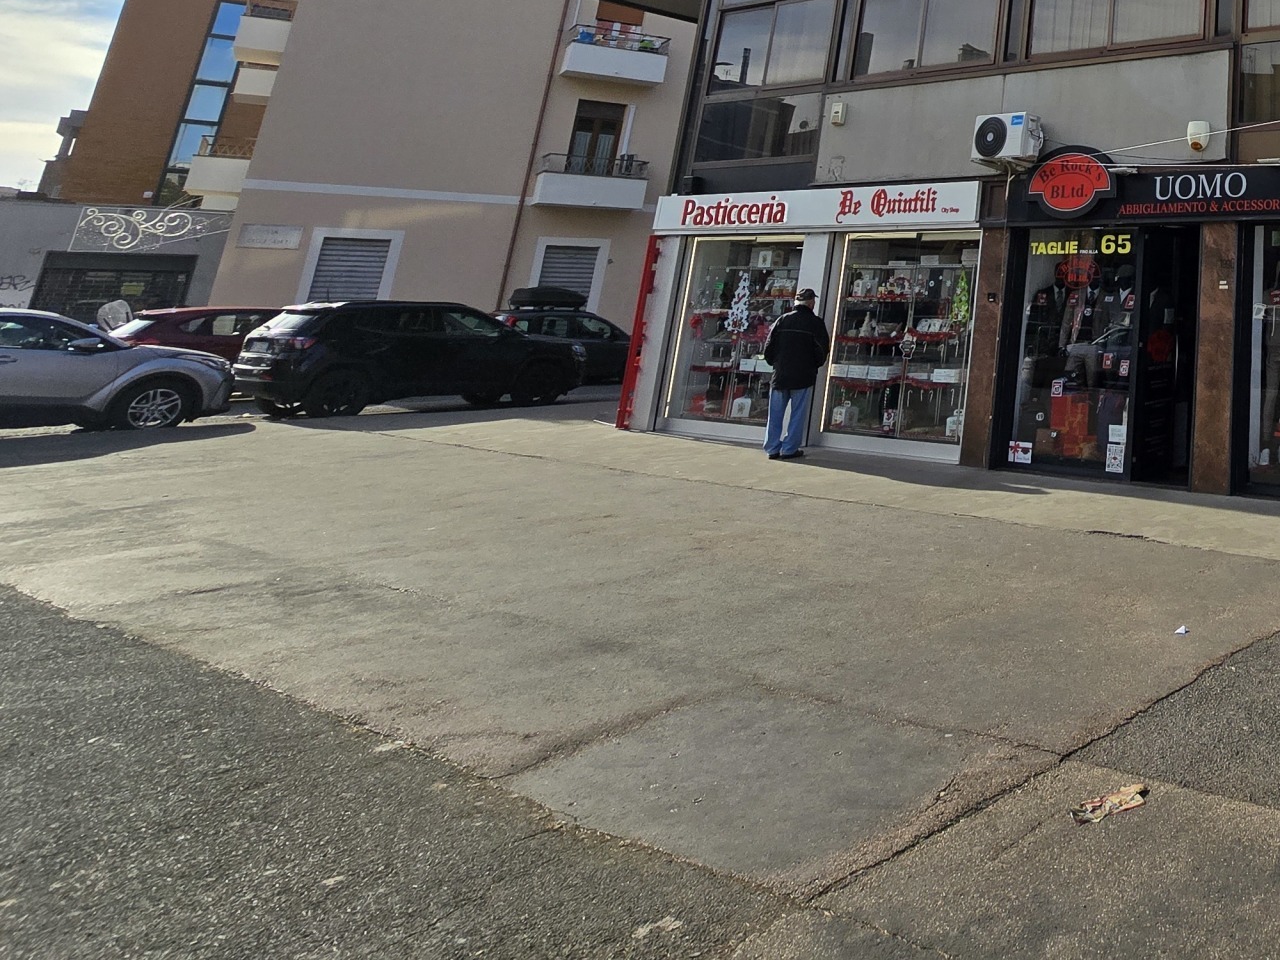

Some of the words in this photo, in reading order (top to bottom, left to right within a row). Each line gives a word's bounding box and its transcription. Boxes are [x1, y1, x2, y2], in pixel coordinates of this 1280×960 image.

[1039, 167, 1056, 183] Be
[1060, 160, 1103, 181] Rock's
[1050, 184, 1088, 198] BLtd.
[1154, 172, 1247, 200] UOMO
[681, 195, 786, 225] Pasticceria
[836, 190, 862, 223] De
[871, 187, 938, 217] Quintili
[1119, 202, 1207, 215] ABBIGLIAMENTO
[1209, 201, 1218, 212] &
[1031, 241, 1078, 255] TAGLIE
[1101, 235, 1131, 254] 65
